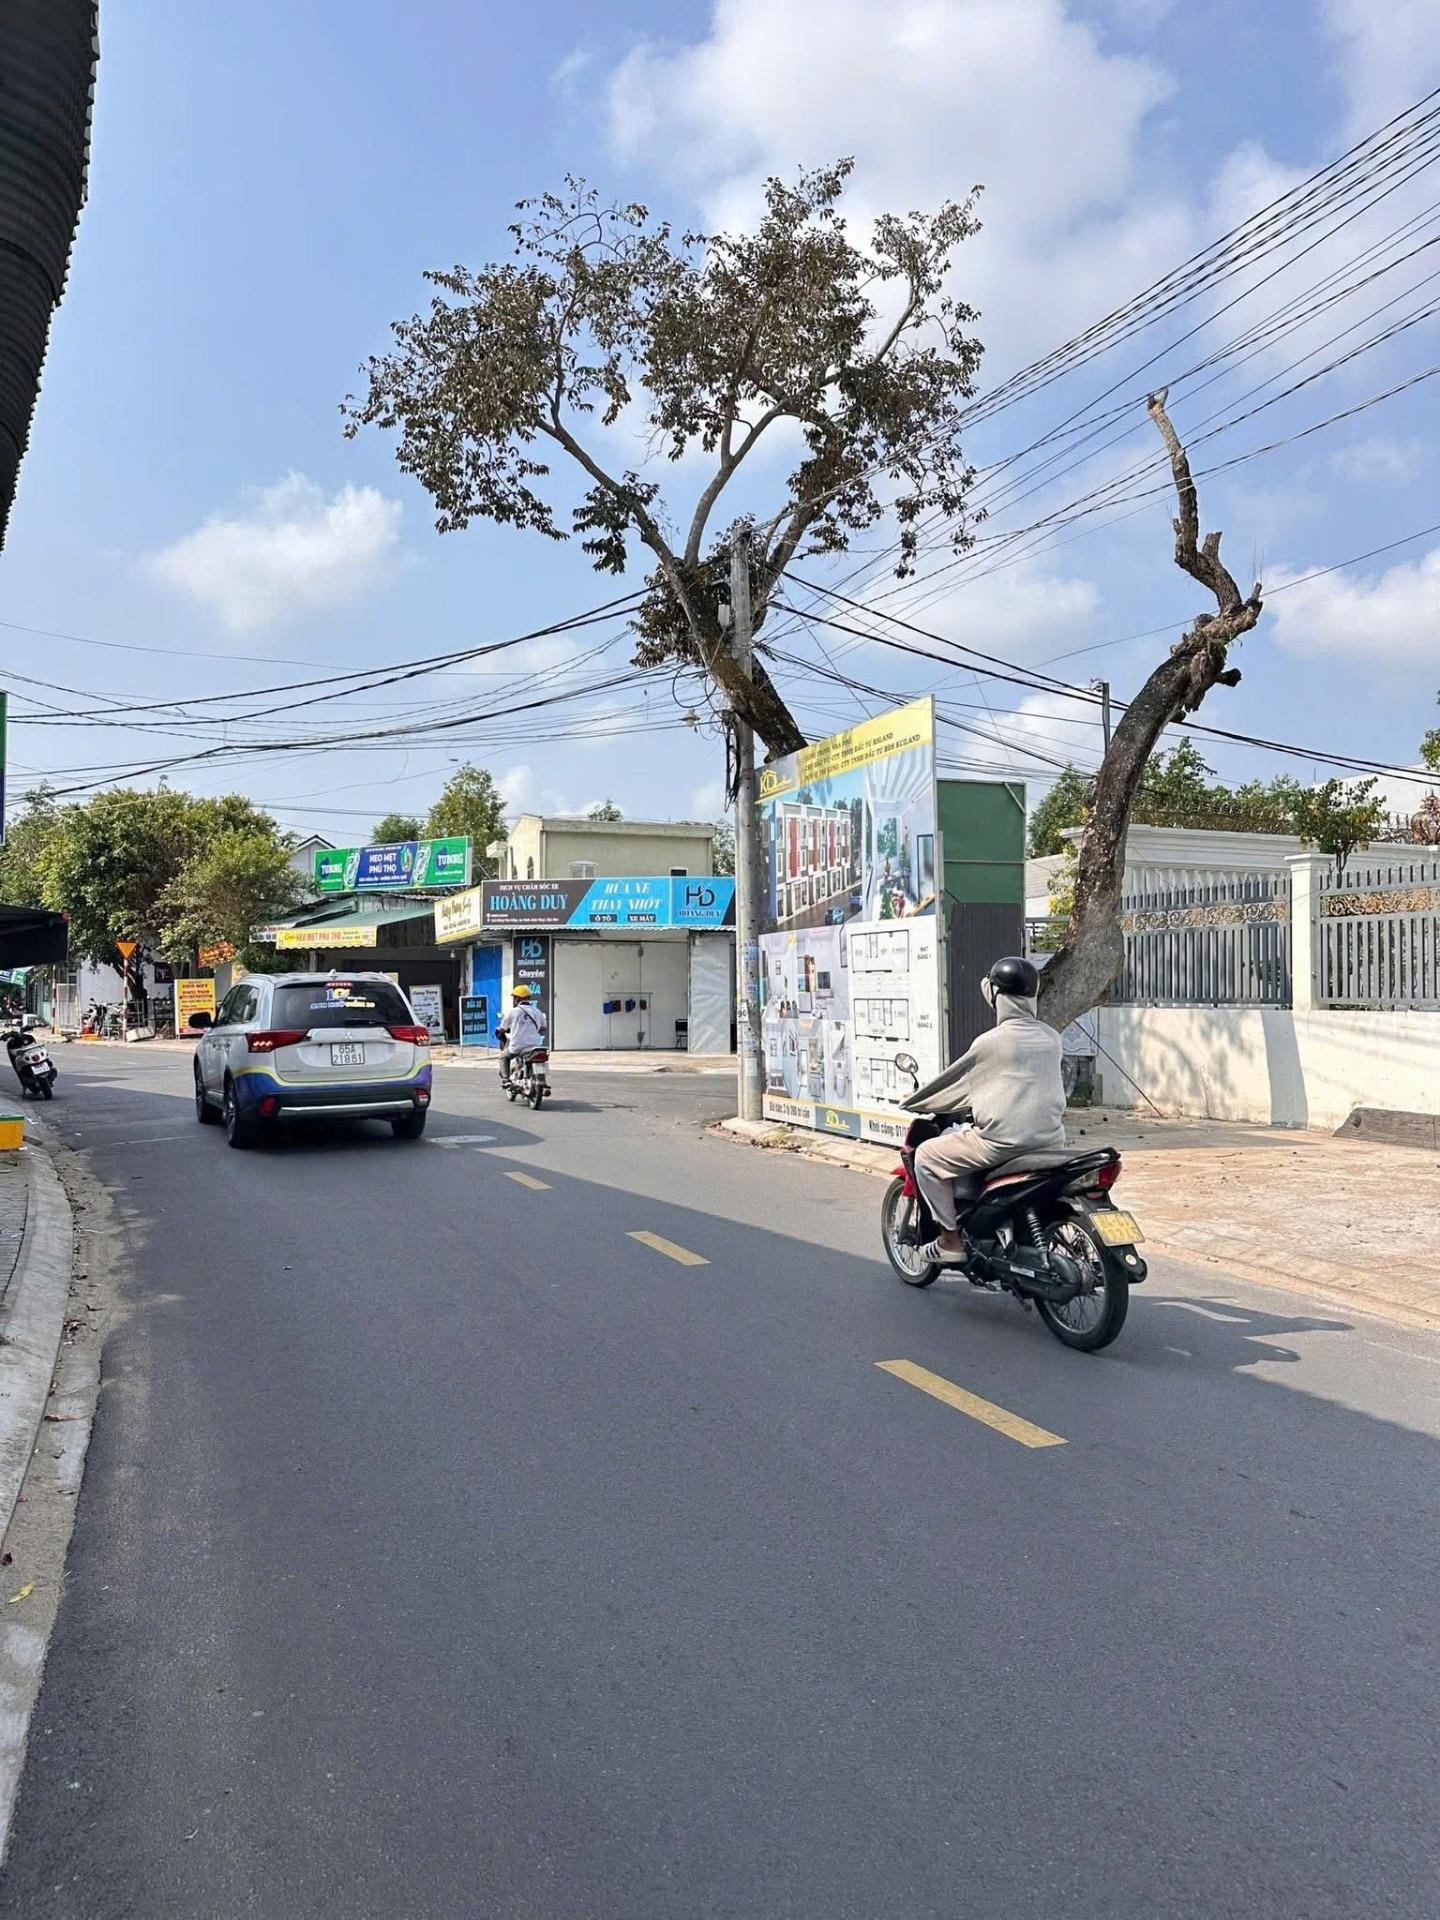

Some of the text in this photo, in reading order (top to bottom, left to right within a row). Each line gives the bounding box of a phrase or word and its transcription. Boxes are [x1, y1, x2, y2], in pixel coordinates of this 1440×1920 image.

[490, 892, 537, 911] HOÀNG
[540, 894, 568, 910] DUY
[640, 914, 655, 922] MÁY
[333, 1054, 362, 1064] 21861
